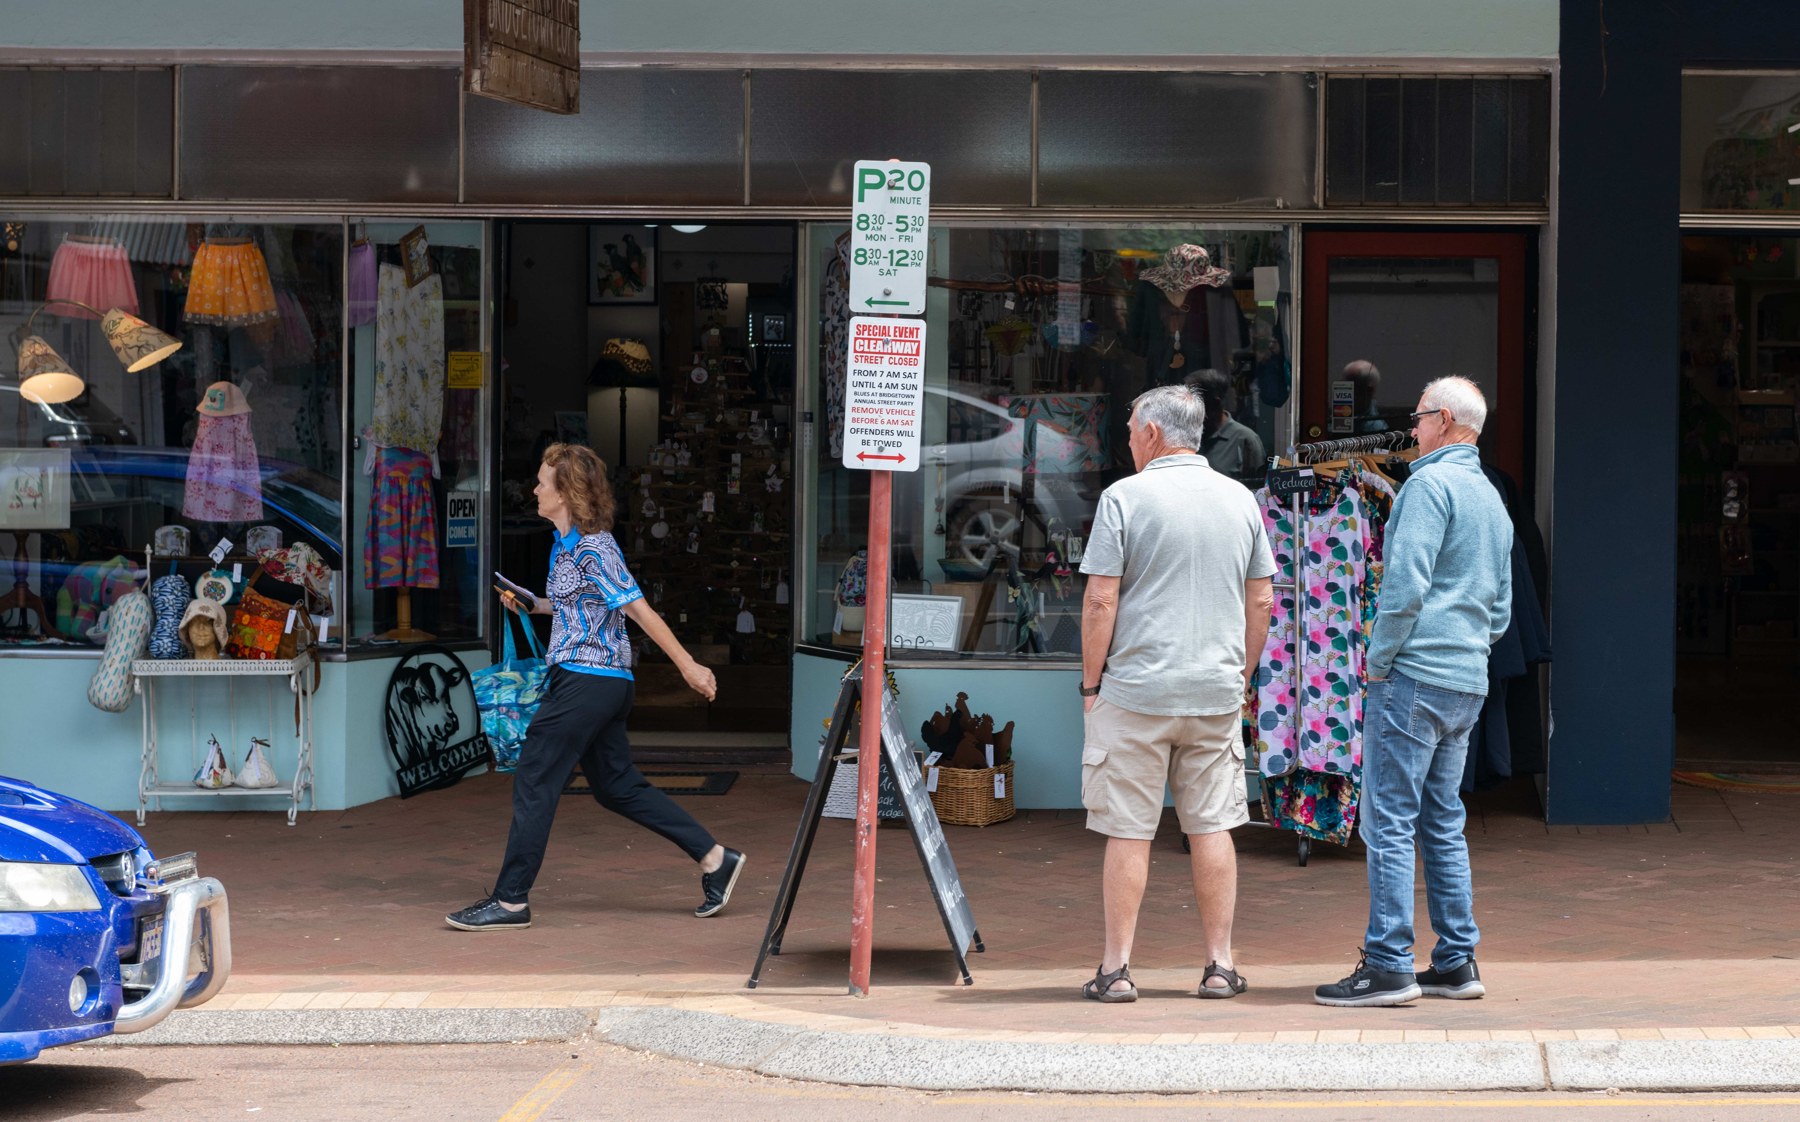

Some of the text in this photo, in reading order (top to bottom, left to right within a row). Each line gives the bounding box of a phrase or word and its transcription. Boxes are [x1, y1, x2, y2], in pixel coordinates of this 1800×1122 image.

[890, 196, 921, 205] MINUTE
[866, 234, 886, 242] MON
[898, 235, 913, 243] FRI
[856, 324, 920, 338] SPECIAL EVENT
[855, 339, 918, 354] CLEARWAY
[854, 355, 918, 366] STREET CLOSED
[853, 369, 877, 377] FROM
[850, 428, 894, 436] OFFENDERS
[873, 440, 902, 448] TOWED
[449, 498, 476, 518] OPEN
[449, 526, 475, 539] COME IN
[400, 737, 487, 788] WELCOME
